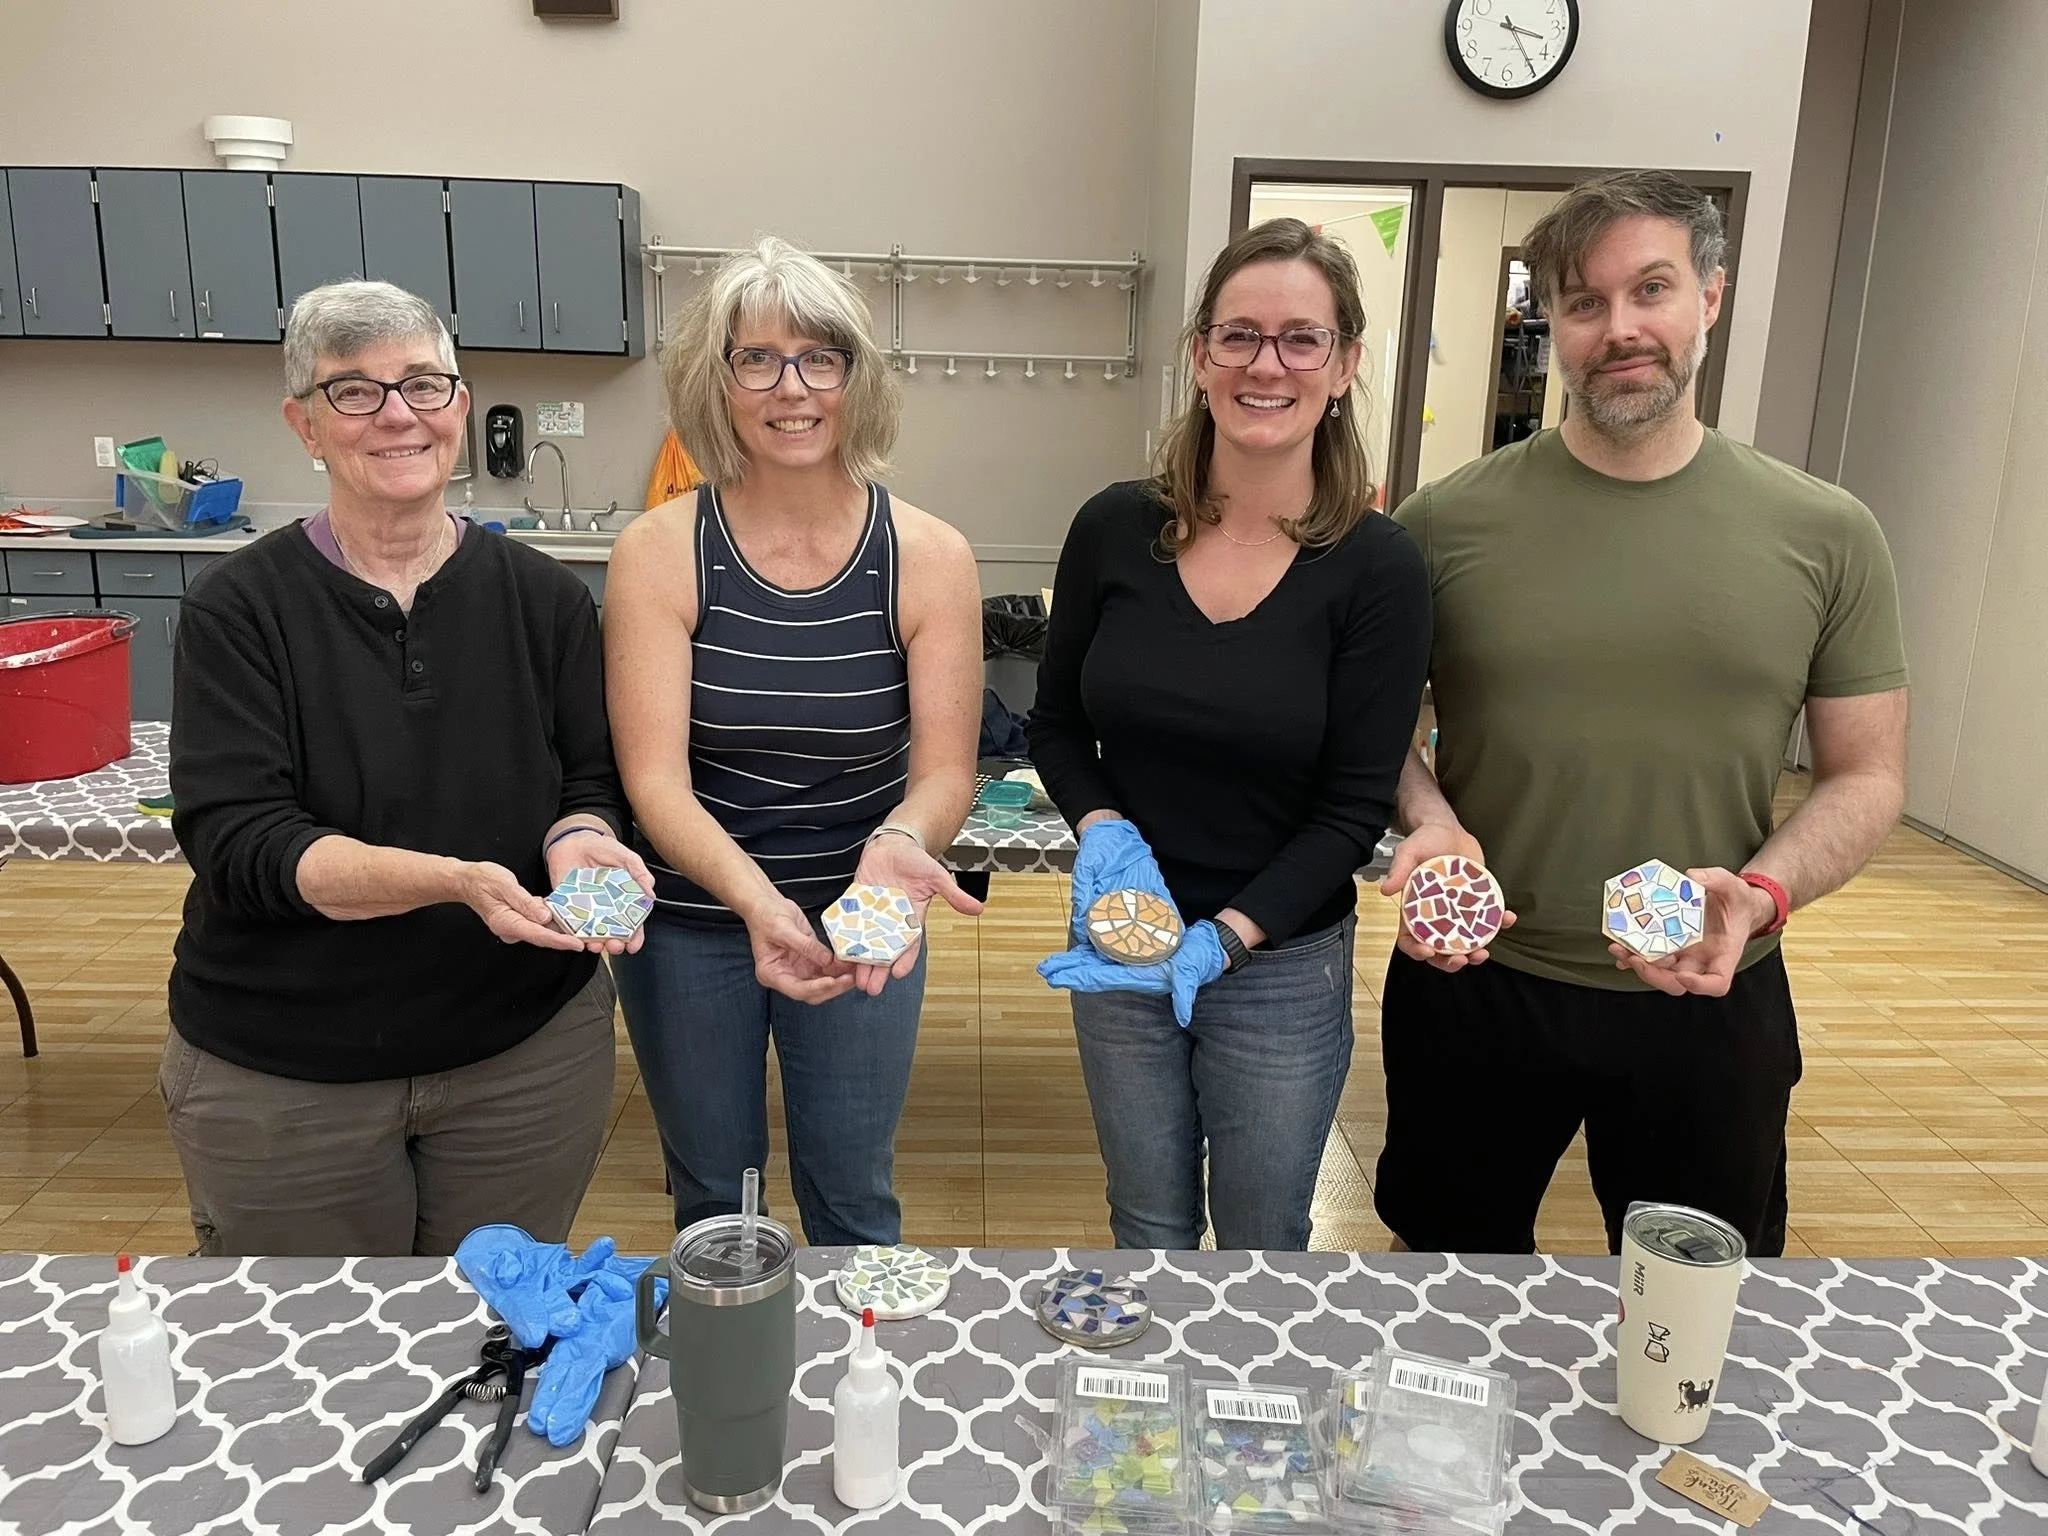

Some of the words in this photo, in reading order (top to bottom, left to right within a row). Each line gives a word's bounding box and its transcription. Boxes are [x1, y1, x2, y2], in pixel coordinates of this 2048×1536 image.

[1470, 0, 1492, 16] 10
[1546, 0, 1556, 14] 2
[1461, 18, 1473, 38] 9
[1550, 19, 1561, 41] 3
[1465, 39, 1478, 59] 8
[1539, 41, 1549, 60] 4
[1482, 57, 1492, 77] 7
[1501, 62, 1513, 82] 6
[1633, 1261, 1645, 1296] MiiR
[1683, 1475, 1738, 1514] Thank
[1708, 1477, 1740, 1496] you
